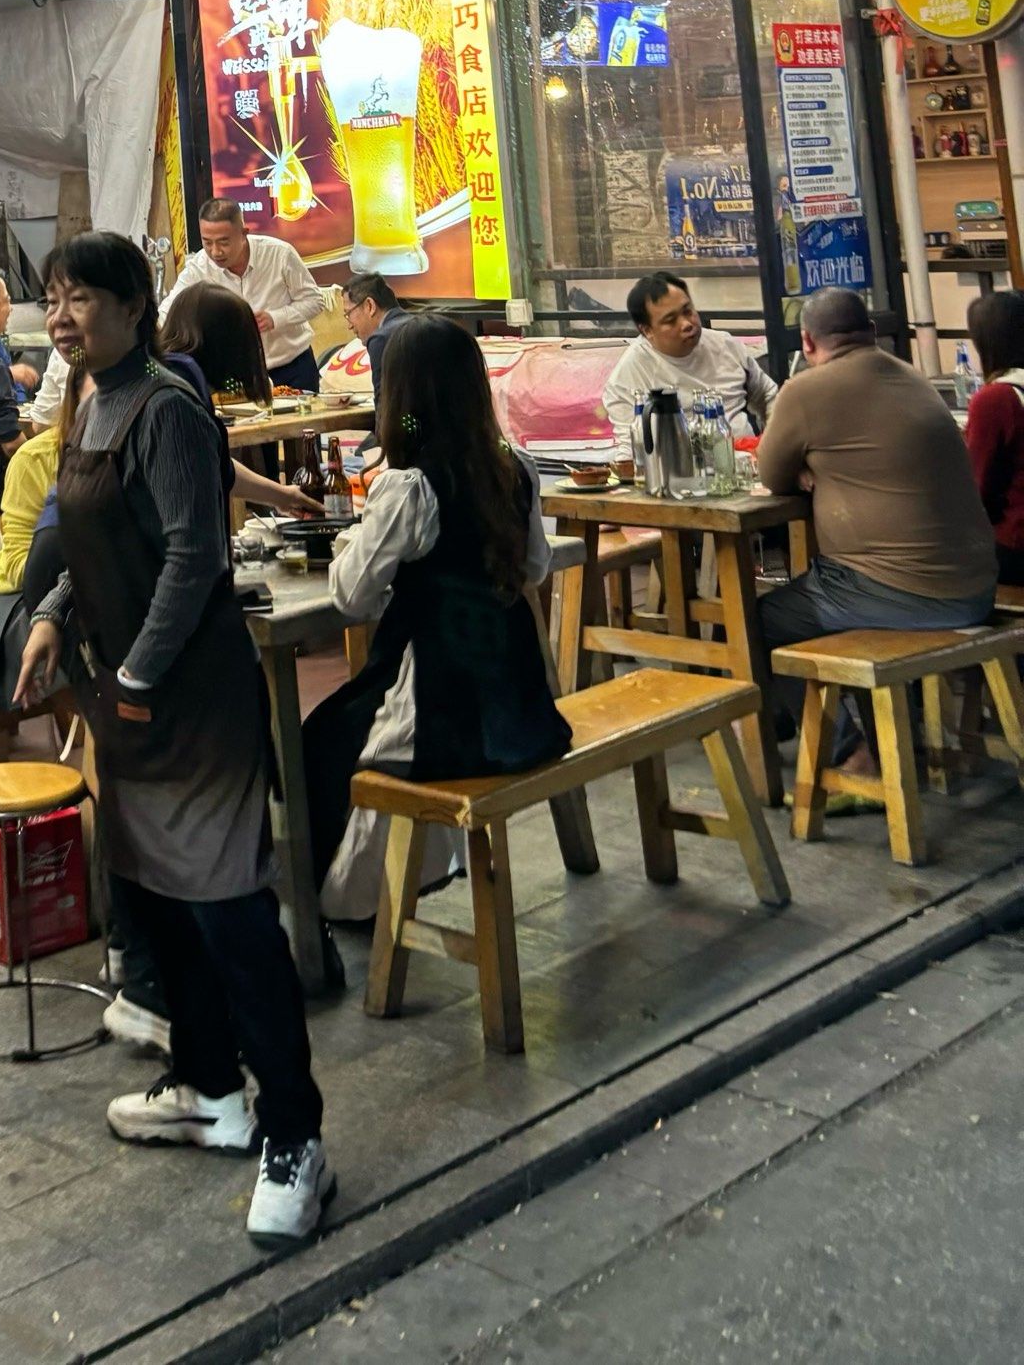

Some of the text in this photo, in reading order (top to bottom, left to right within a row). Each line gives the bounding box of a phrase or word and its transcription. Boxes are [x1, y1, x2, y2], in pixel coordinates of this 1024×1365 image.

[794, 28, 840, 45] 打架成本高
[235, 98, 260, 112] BEER
[804, 251, 866, 288] 欢迎光临
